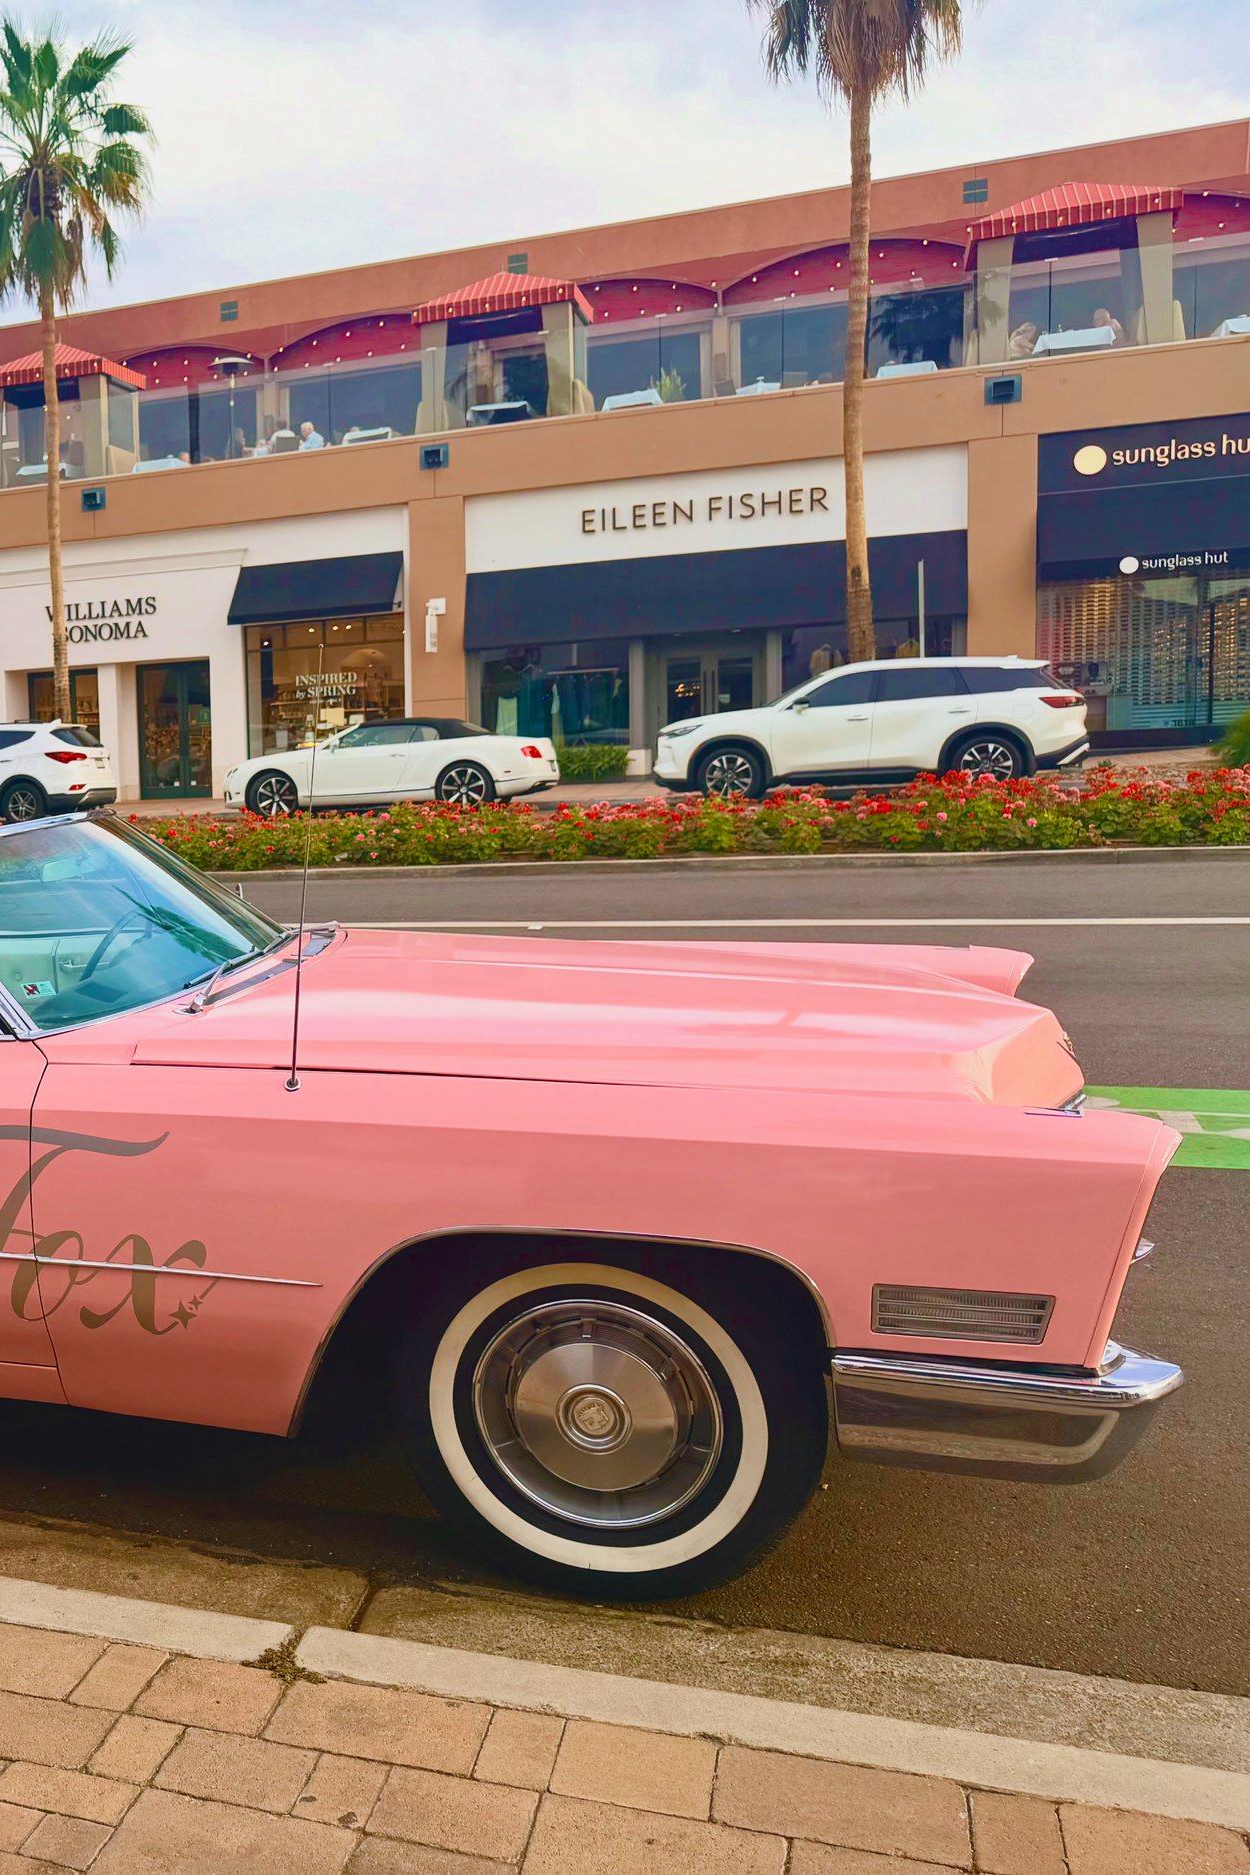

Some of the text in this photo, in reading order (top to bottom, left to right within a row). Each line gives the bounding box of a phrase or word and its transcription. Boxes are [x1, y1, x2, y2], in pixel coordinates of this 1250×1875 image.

[1112, 439, 1216, 467] sunglass
[581, 487, 829, 533] EILEEN FISHER
[1142, 551, 1229, 570] sunglass hut
[295, 671, 358, 687] INSPIRED
[295, 684, 356, 700] by SPRING
